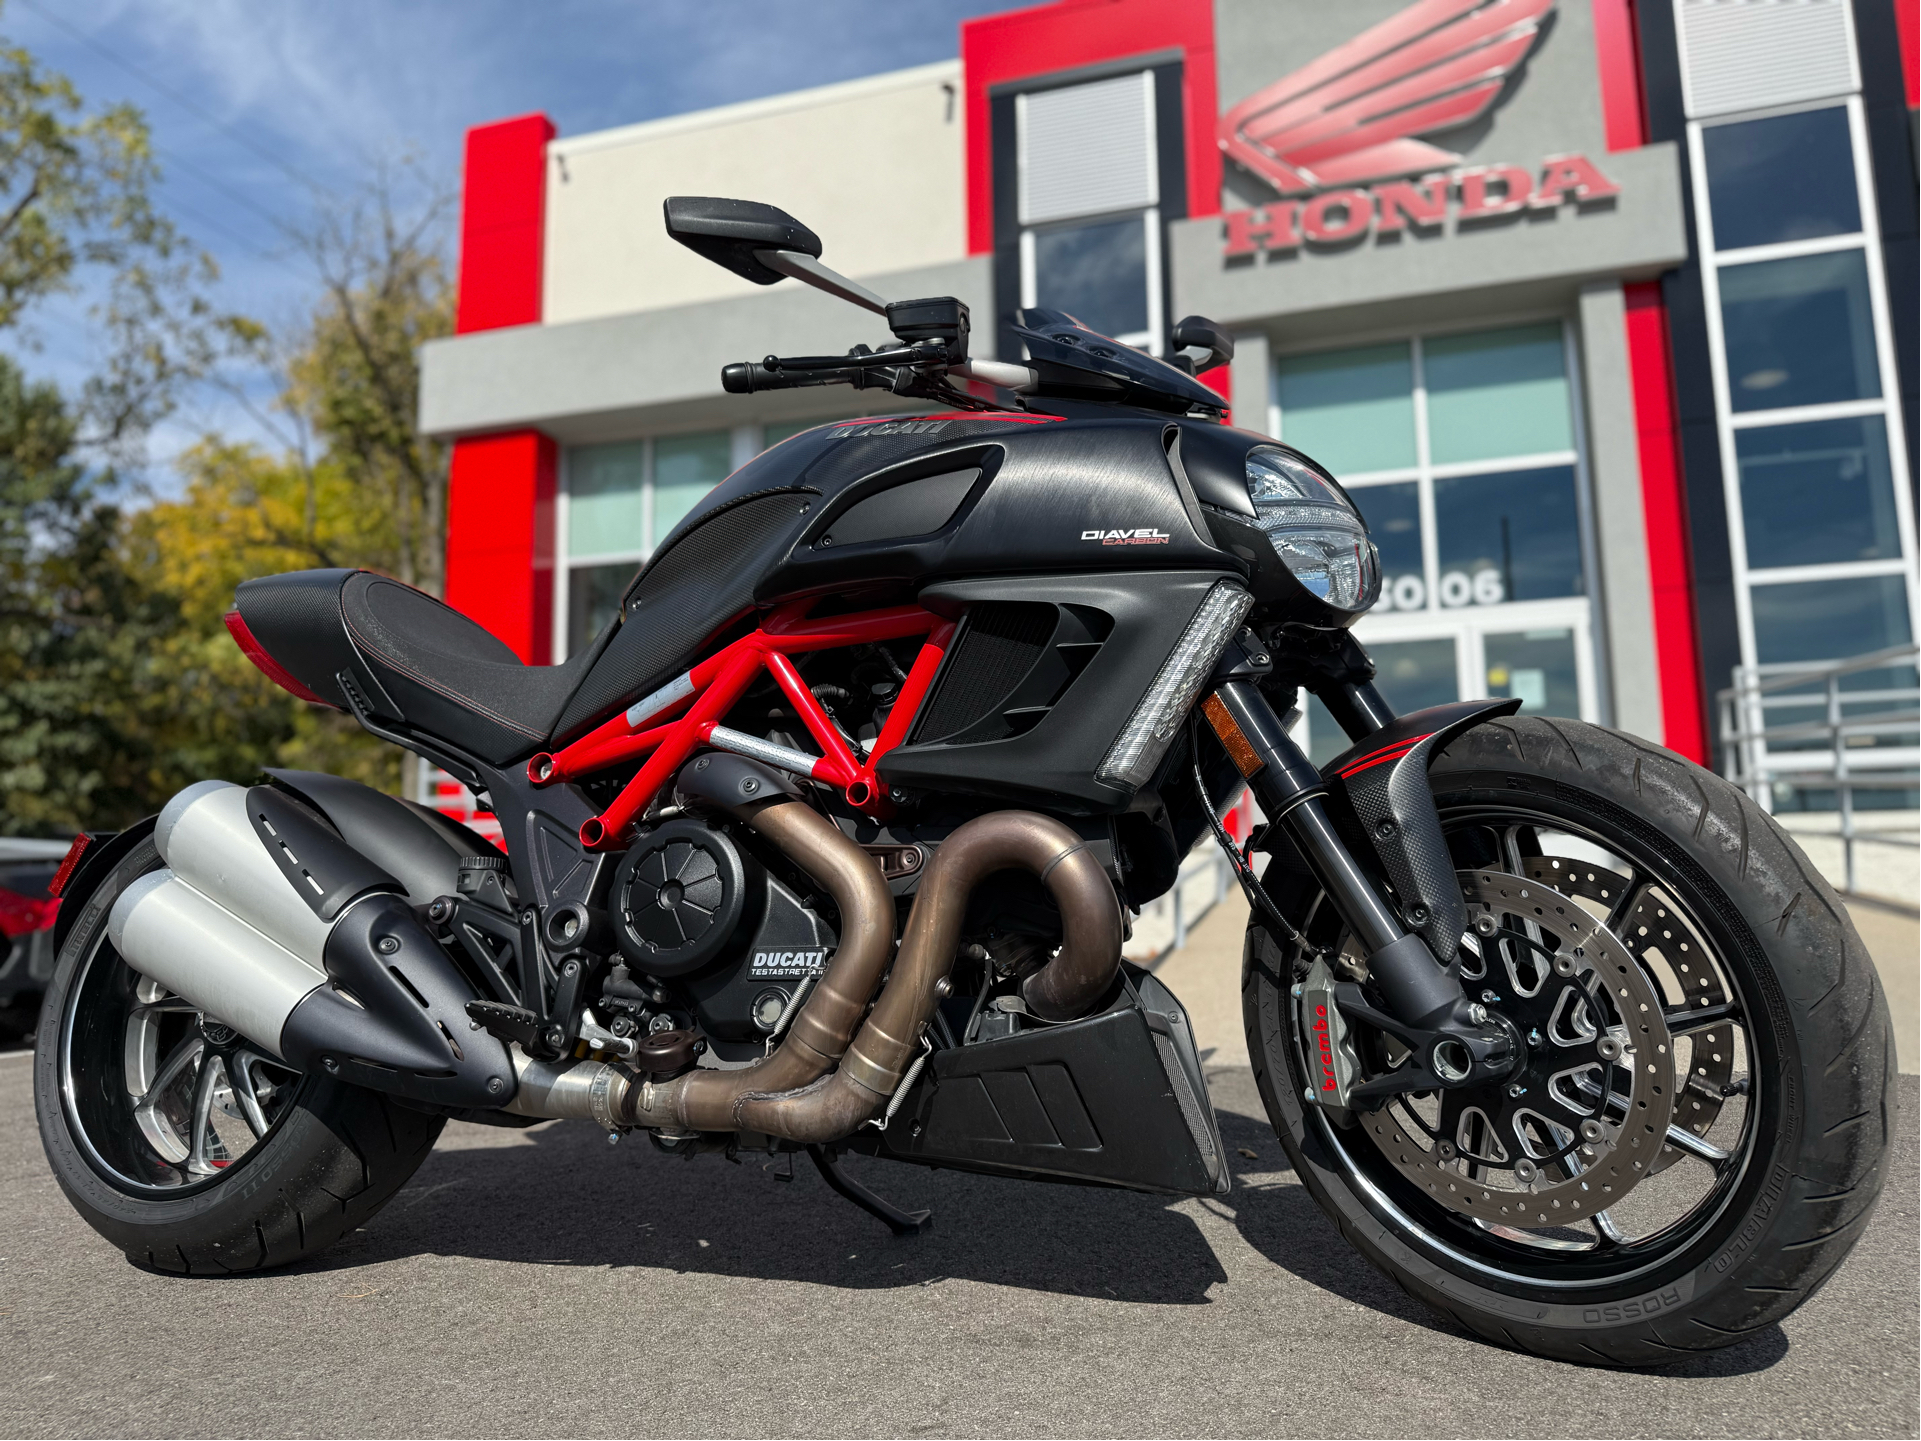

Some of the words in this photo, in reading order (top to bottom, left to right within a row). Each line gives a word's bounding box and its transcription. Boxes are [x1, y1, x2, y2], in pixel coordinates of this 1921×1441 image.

[1223, 154, 1622, 257] HONDA
[825, 419, 952, 440] DUCATI
[1081, 528, 1170, 540] DIAVEL
[1102, 537, 1169, 546] CARBON
[65, 903, 101, 957] PIRELLI
[753, 952, 823, 967] DUCATI
[1312, 1004, 1337, 1091] brembo
[1712, 1163, 1790, 1274] DIABLO
[1583, 1286, 1682, 1324] ROSSO
